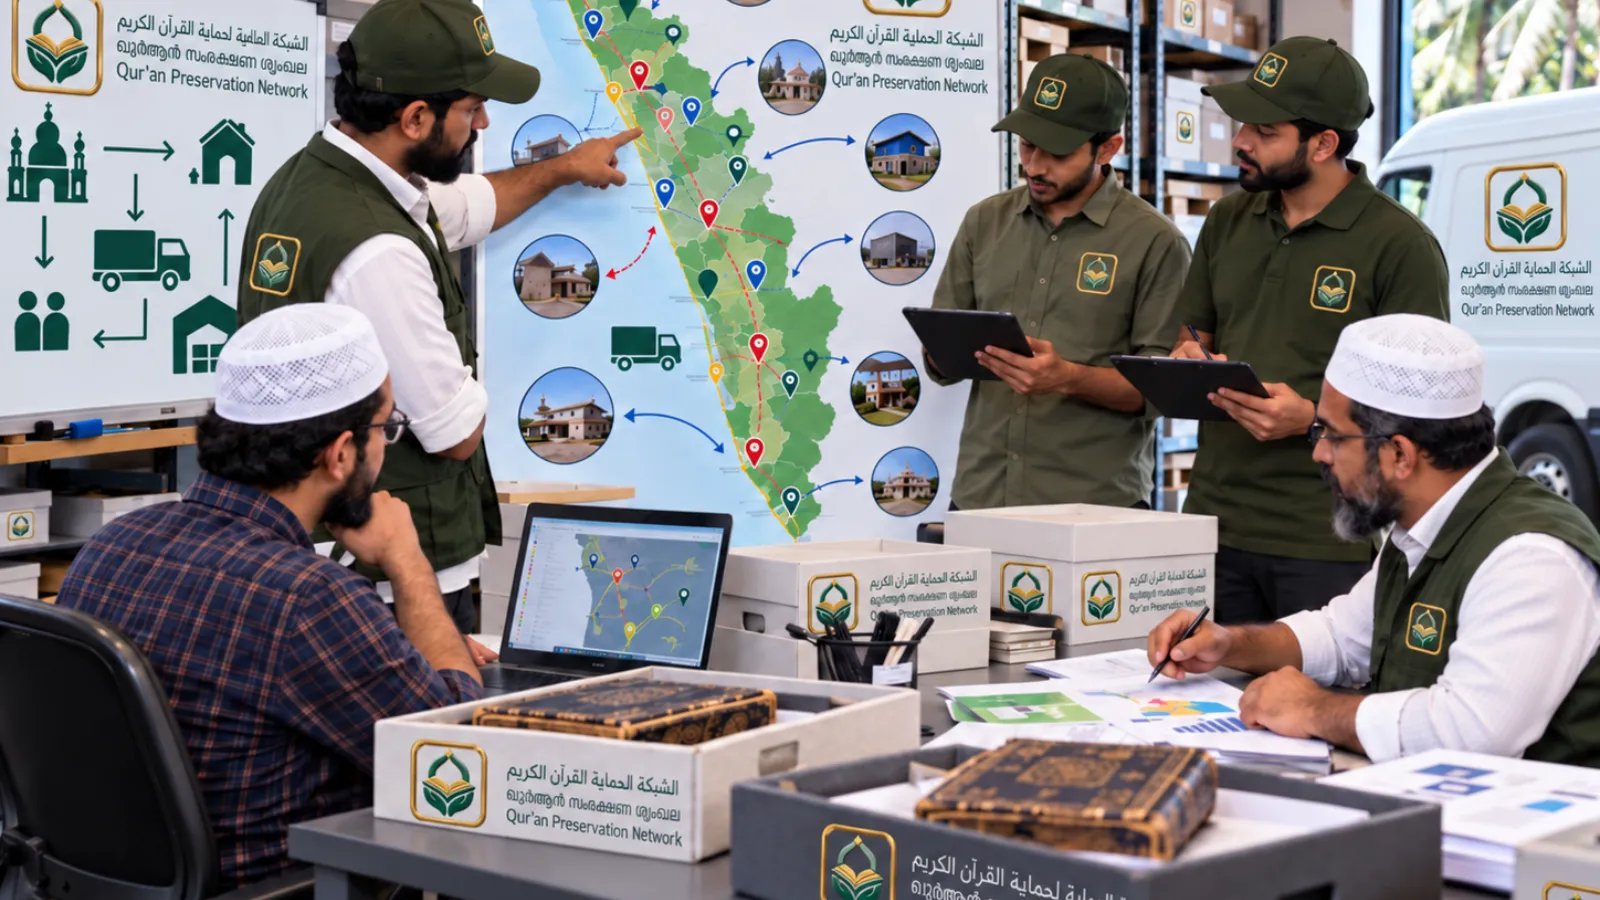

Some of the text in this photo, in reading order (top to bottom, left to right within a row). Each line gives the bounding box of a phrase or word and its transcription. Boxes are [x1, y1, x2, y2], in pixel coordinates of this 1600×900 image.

[117, 15, 154, 33] الكريم
[158, 15, 194, 37] القرآن
[198, 20, 232, 42] لحماية
[830, 25, 864, 42] الكريم
[867, 24, 899, 45] القرآن
[273, 31, 309, 52] الشبكة
[946, 31, 983, 50] الشبكة
[117, 62, 308, 100] Qur'an Preservation Network
[873, 73, 941, 91] Preservation
[944, 78, 988, 94] Network
[1461, 261, 1490, 278] الكريم
[1560, 260, 1592, 277] الشبكة
[1496, 303, 1554, 316] Preservation
[1556, 303, 1594, 316] Network
[947, 604, 978, 616] Network
[507, 764, 546, 782] الكريم
[550, 764, 587, 788] القرآن
[637, 776, 678, 797] الشبكة
[552, 815, 628, 839] Preservation
[632, 826, 682, 847] Network
[912, 855, 956, 876] الكريم
[960, 859, 1005, 886] القرآن
[1010, 871, 1060, 899] لحماية
